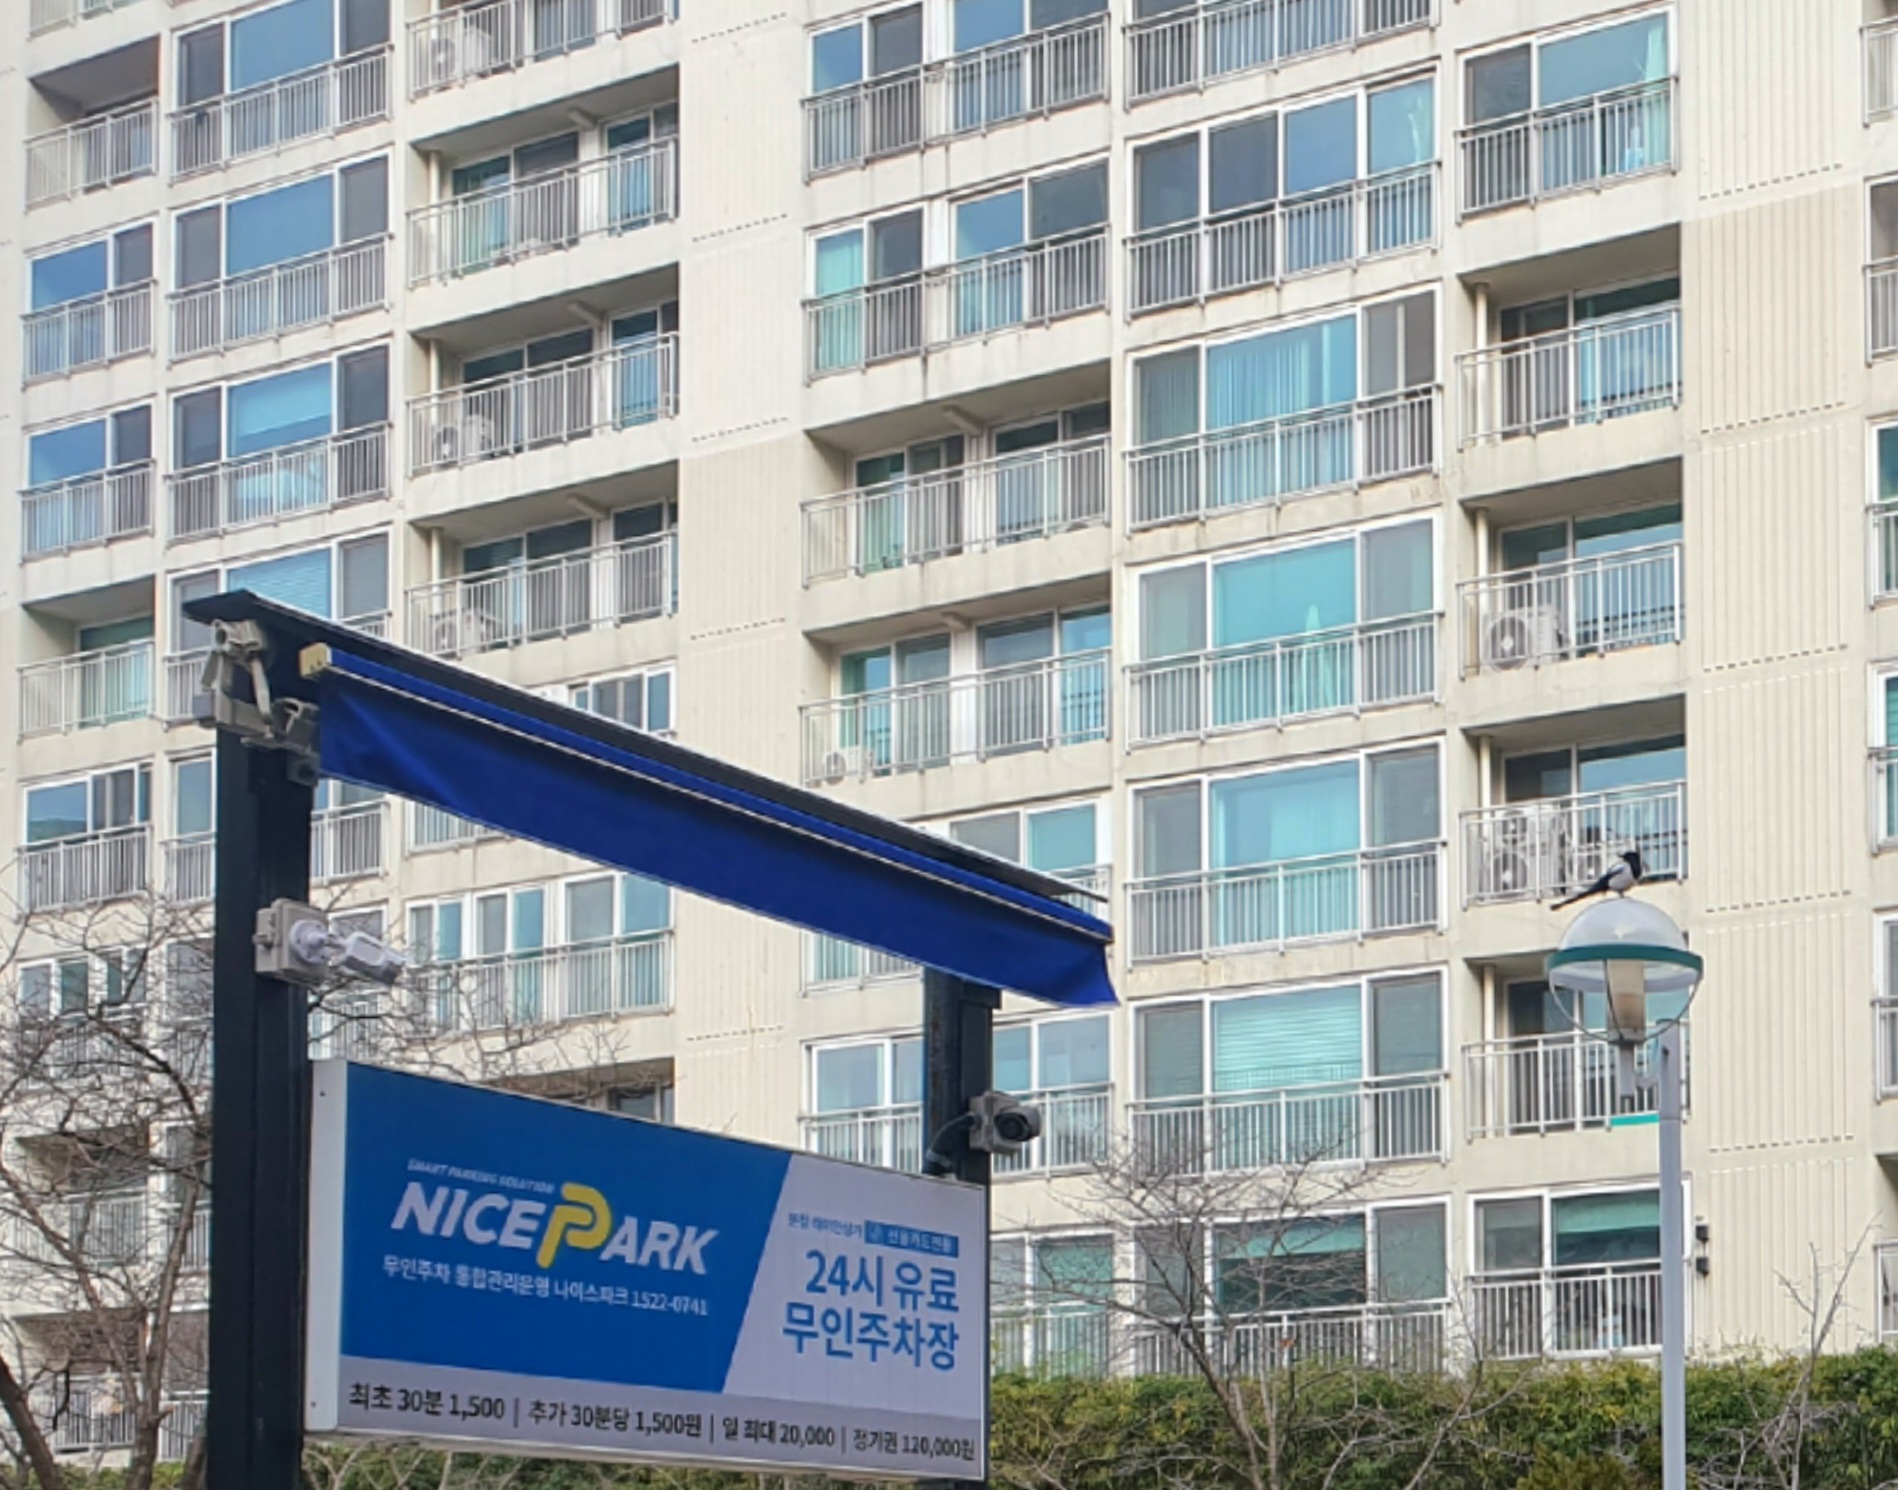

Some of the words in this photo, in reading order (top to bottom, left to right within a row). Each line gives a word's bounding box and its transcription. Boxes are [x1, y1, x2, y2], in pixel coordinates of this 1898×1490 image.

[383, 1254, 450, 1284] 무인주차
[455, 1264, 550, 1298] 통합관리운영
[554, 1279, 629, 1305] 나이스파크
[631, 1291, 708, 1316] 1522-0741
[805, 1248, 884, 1307] 24시
[892, 1261, 959, 1313] 유료
[782, 1301, 960, 1371] 무인주차장
[350, 1381, 393, 1411] 최초
[397, 1388, 444, 1417] 30분
[449, 1393, 505, 1421] 1,500
[528, 1399, 568, 1427] 추가
[571, 1404, 630, 1432] 30분당
[635, 1410, 702, 1439] 1,500원
[722, 1416, 739, 1440] 일
[744, 1419, 776, 1444] 최대
[779, 1424, 835, 1449] 20,000
[852, 1427, 898, 1454] 정기권
[902, 1434, 975, 1462] 120,000원
